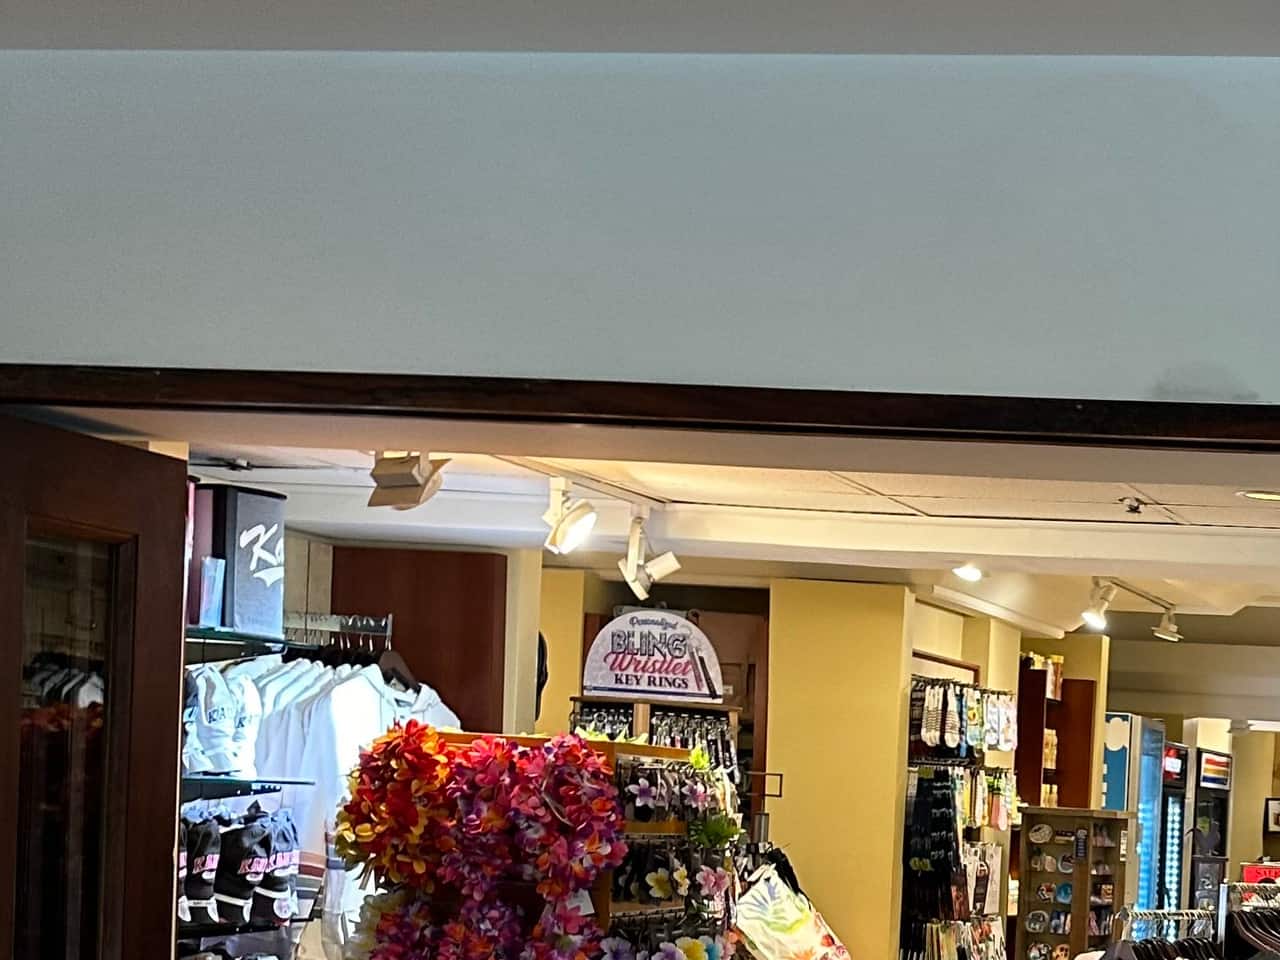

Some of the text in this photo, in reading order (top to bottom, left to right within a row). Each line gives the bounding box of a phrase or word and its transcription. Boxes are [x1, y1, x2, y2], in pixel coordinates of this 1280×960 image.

[611, 630, 688, 658] BLING
[603, 650, 693, 676] Wristlet
[614, 673, 689, 690] KEY RINGS
